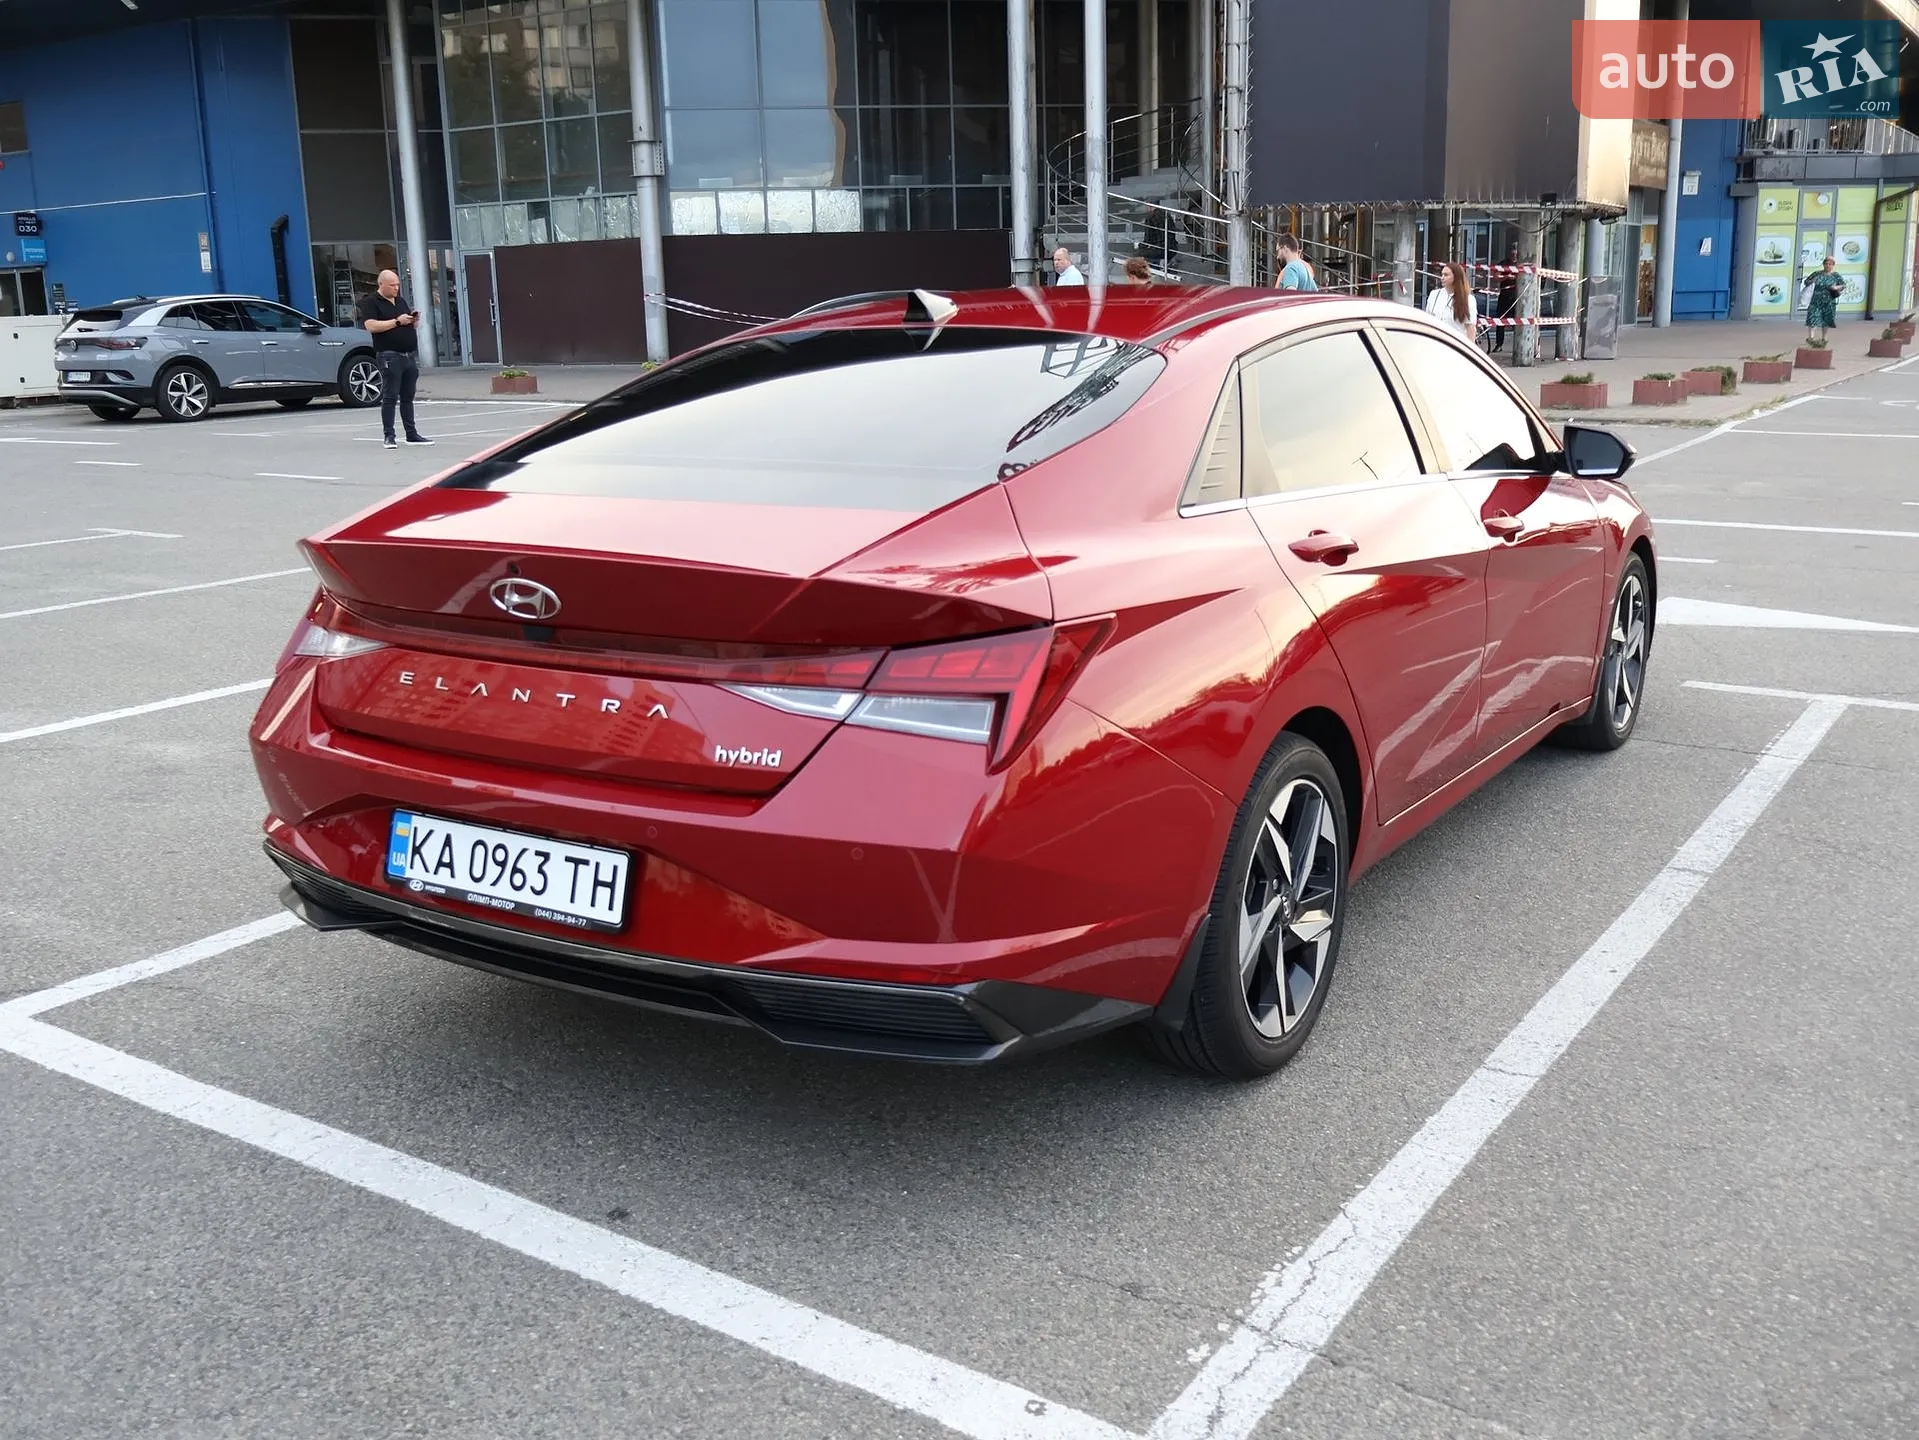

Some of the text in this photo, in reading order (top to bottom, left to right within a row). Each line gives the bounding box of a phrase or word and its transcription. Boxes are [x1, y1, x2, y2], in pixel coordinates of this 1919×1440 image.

[399, 670, 669, 719] ELANTRA
[714, 745, 782, 768] hybrid
[391, 851, 406, 867] UA
[409, 826, 619, 911] KA 0963 TH
[535, 907, 587, 926] (044) 394-94-77
